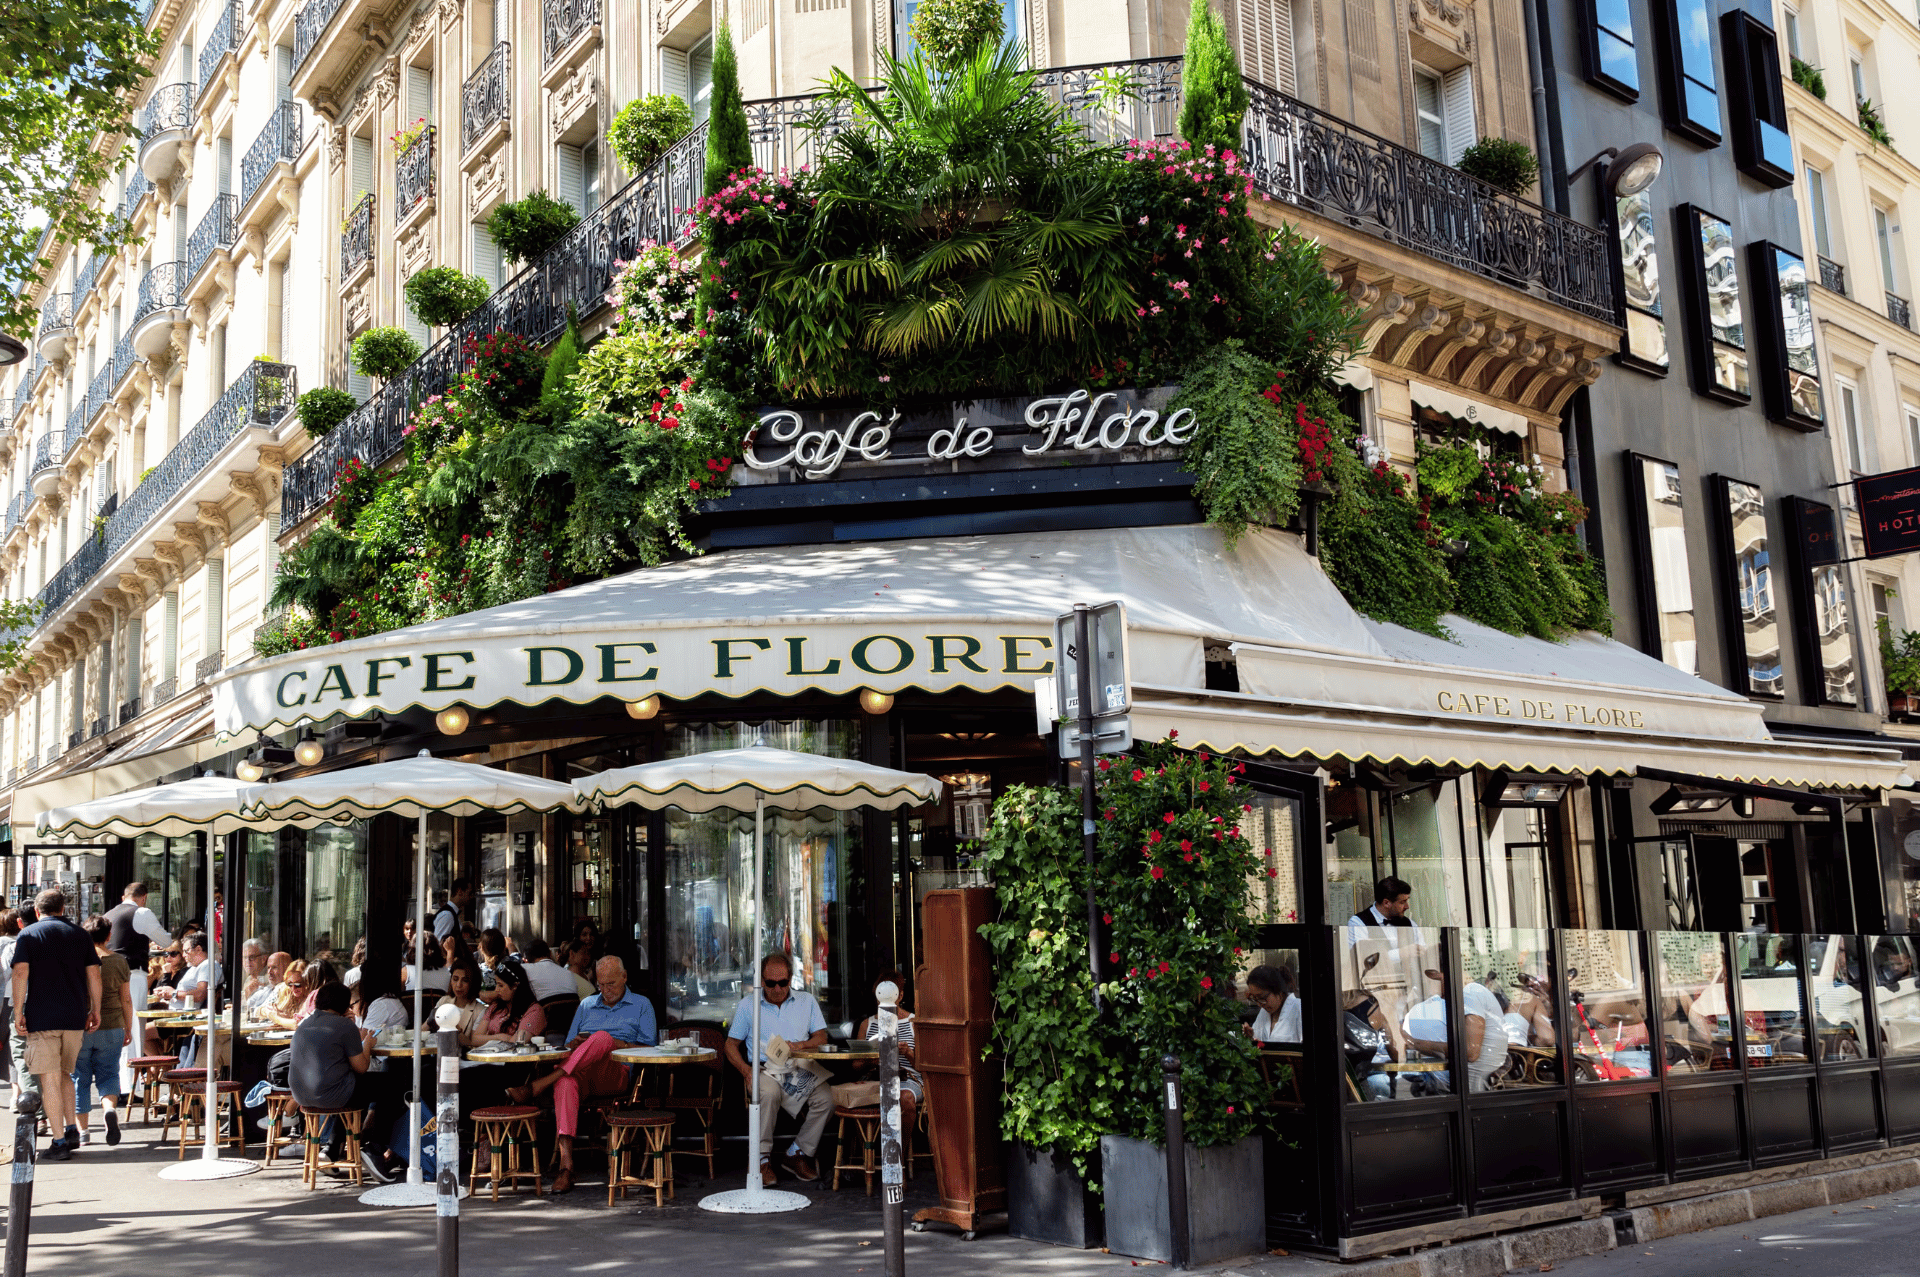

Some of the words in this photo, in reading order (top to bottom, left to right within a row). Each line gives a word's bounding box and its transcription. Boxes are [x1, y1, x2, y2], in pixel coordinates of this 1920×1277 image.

[743, 406, 900, 480] Café
[927, 417, 994, 459] de
[1022, 389, 1199, 456] Flore
[276, 650, 478, 708] CAFE
[522, 641, 660, 687] DE
[709, 634, 1055, 679] FLORE
[1437, 691, 1510, 716] CAFE
[1520, 699, 1554, 720] DE
[1565, 704, 1644, 728] FLORE
